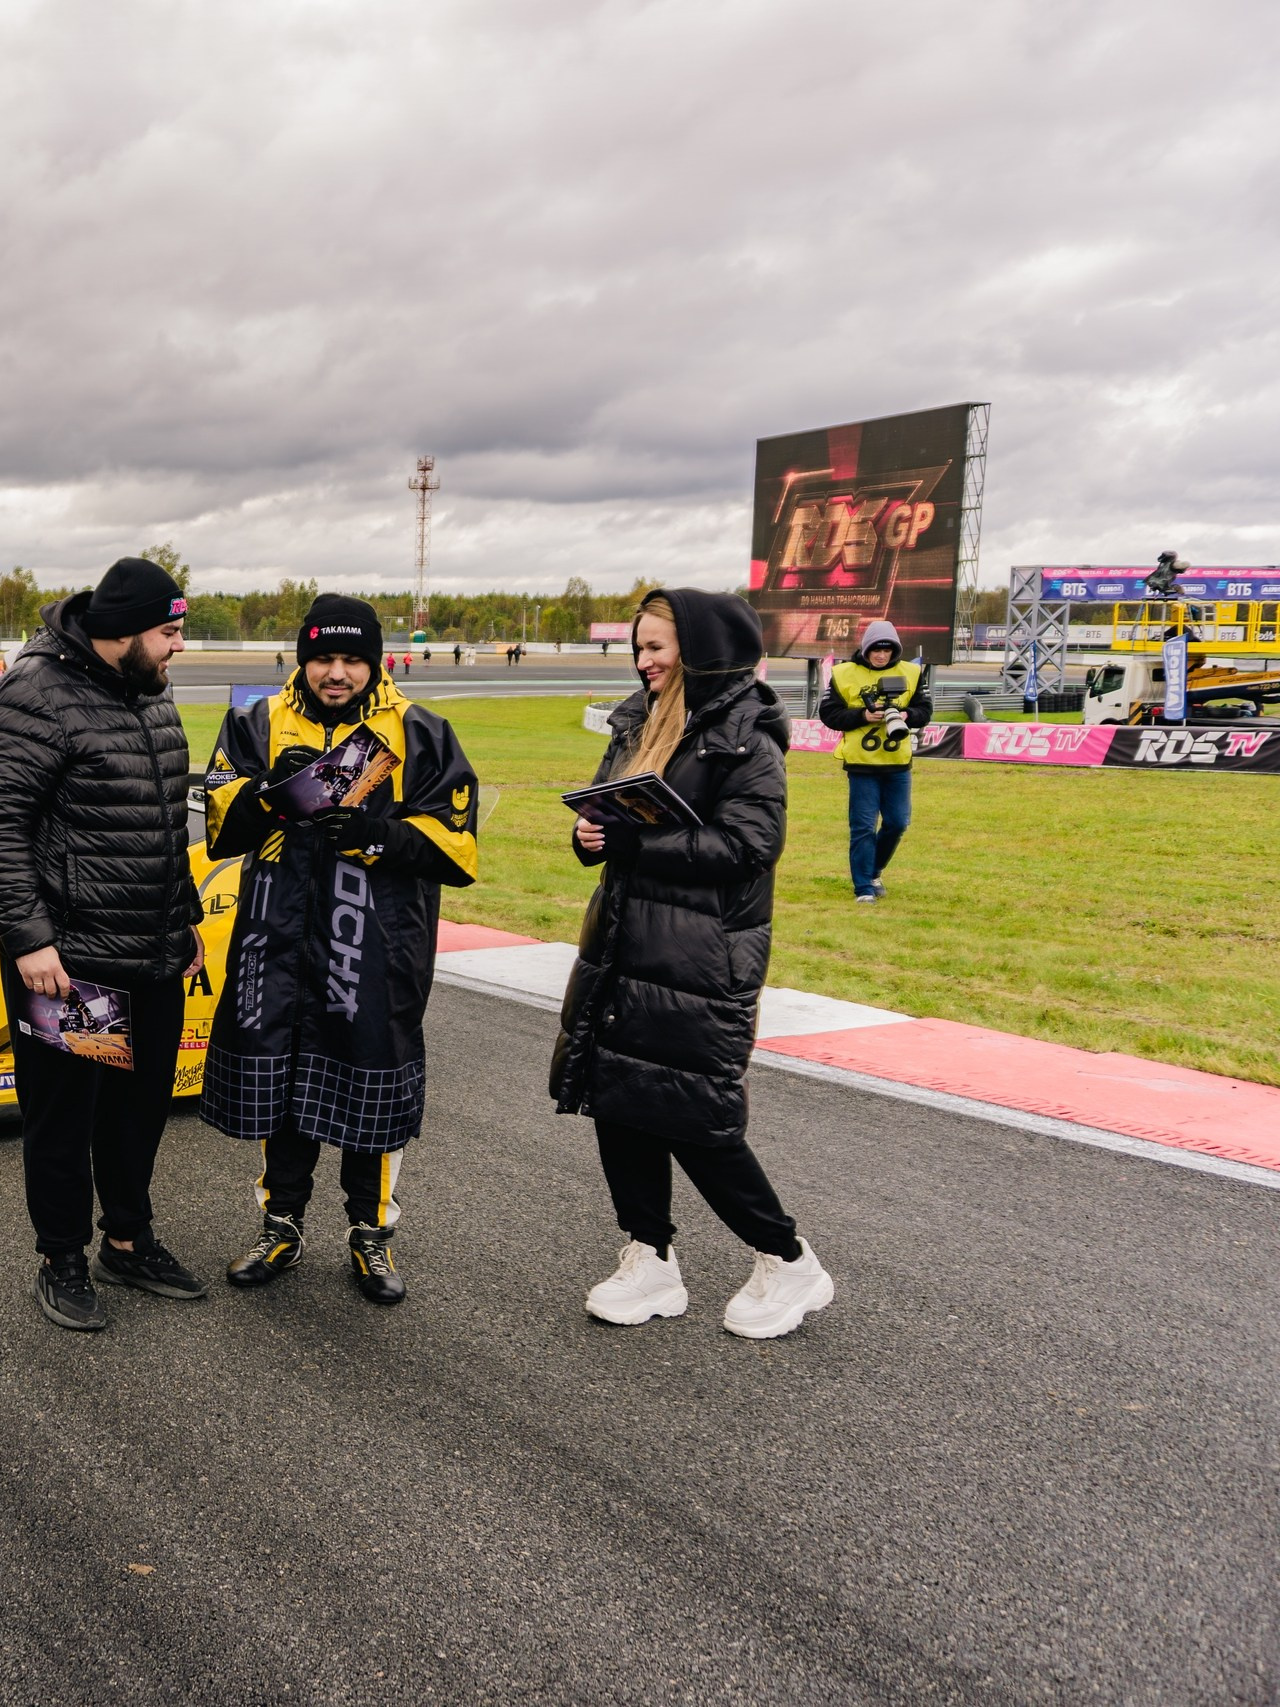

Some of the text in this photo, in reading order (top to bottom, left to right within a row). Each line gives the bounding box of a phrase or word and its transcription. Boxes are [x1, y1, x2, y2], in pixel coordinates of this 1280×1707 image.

[885, 502, 935, 548] GP
[1063, 583, 1087, 596] ВТБ
[1227, 583, 1252, 596] ВТБ
[321, 625, 362, 635] TAKAYAMA
[826, 618, 850, 637] 7:45
[922, 726, 950, 746] TV
[986, 726, 1090, 757] RDS TV
[1134, 730, 1272, 763] RDS TV
